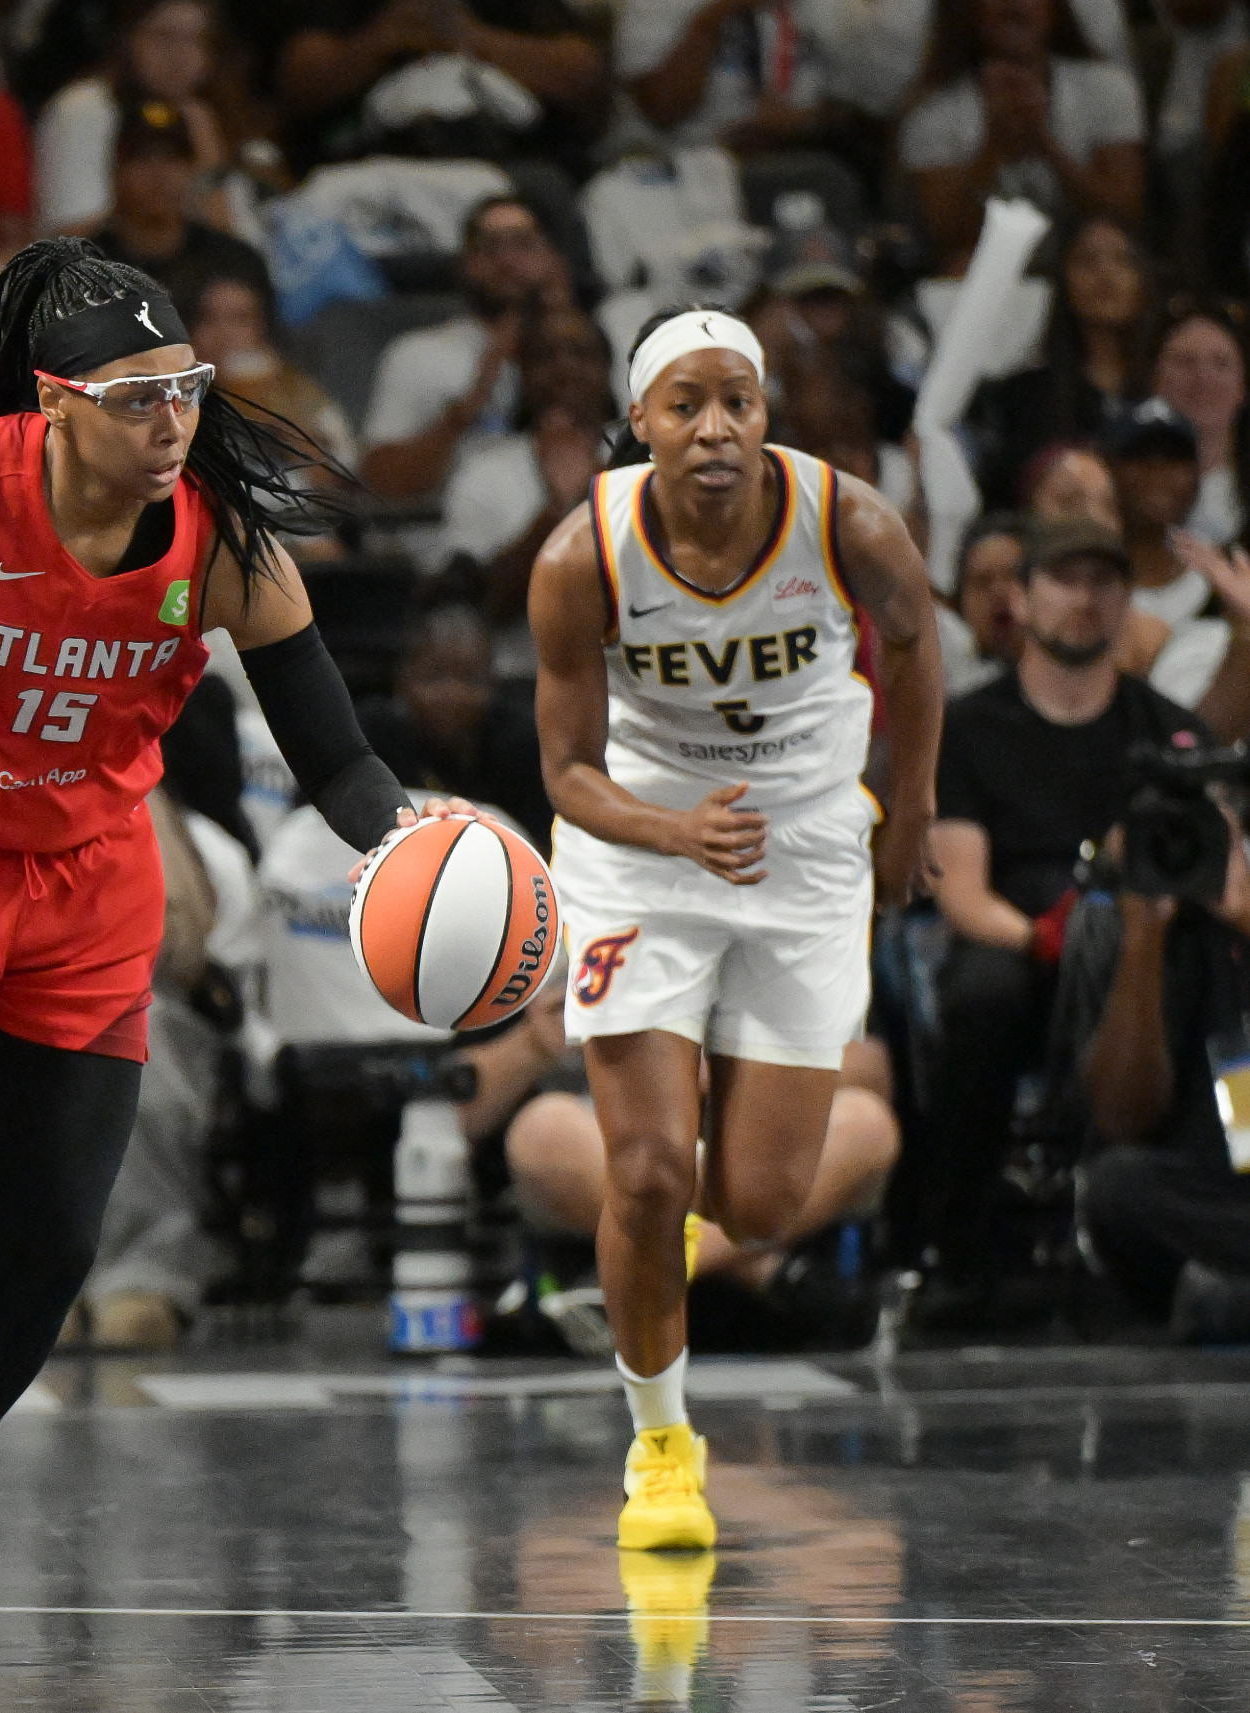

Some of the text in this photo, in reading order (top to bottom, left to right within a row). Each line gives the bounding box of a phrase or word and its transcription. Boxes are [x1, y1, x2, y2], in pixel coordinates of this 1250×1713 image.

[622, 624, 819, 687] FEVER
[11, 688, 98, 743] 15
[46, 767, 87, 786] App
[489, 874, 549, 1006] Wilson
